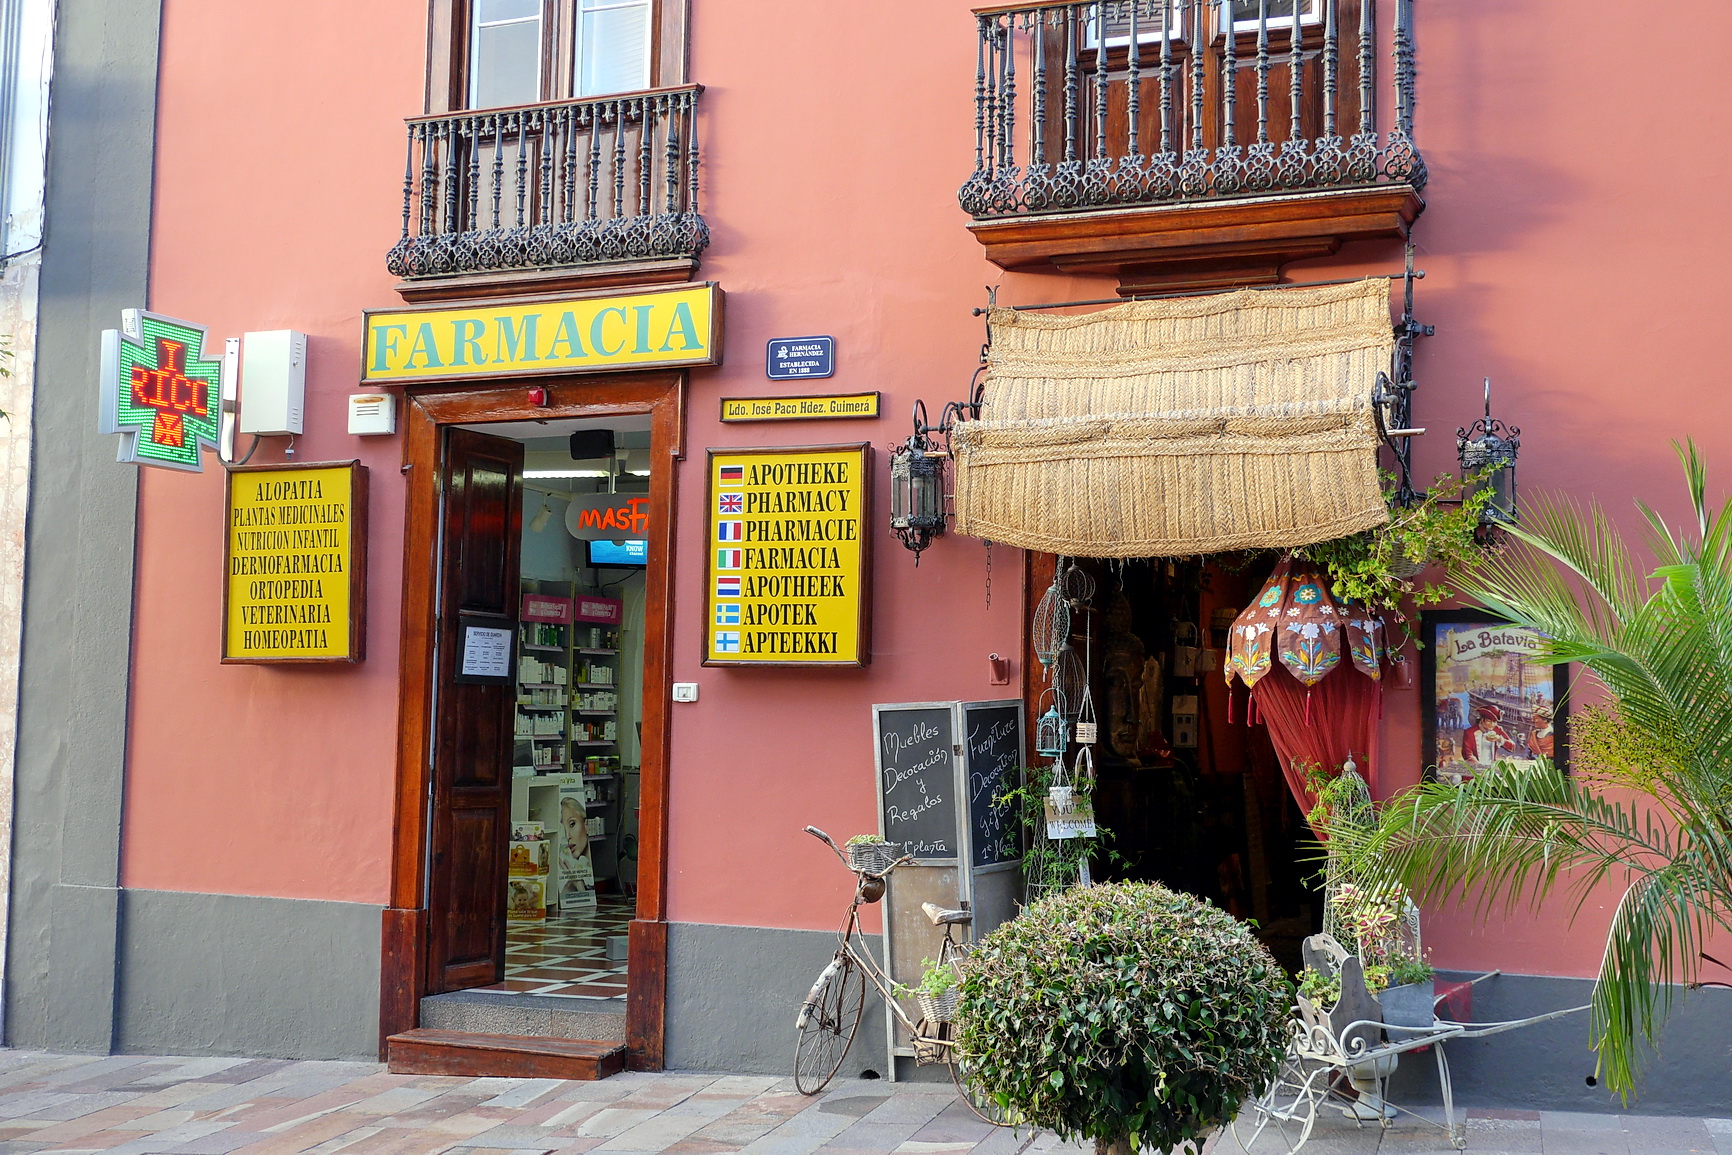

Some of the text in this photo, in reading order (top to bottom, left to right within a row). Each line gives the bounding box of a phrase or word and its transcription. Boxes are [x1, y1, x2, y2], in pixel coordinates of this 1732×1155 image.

[370, 302, 704, 371] FARMACIA
[728, 399, 870, 416] Ldo. José Paco Hdez. Guimerá
[747, 462, 849, 486] APOTHEKE
[255, 480, 323, 502] ALOPATIA
[746, 490, 851, 514] PHARMACY
[233, 503, 345, 527] PLANTAS MEDICINALES
[237, 528, 340, 551] NUTRICION INFANTIL
[745, 518, 857, 542] PHARMACIE
[231, 553, 344, 576] DERMOFARMACIA
[743, 547, 841, 570] FARMACIA
[249, 579, 324, 601] ORTOPEDIA
[743, 575, 846, 598] APOTHEEK
[241, 604, 332, 625] VETERINARIA
[743, 604, 818, 626] APOTEK
[243, 629, 329, 650] HOMEOPATIA
[742, 631, 839, 654] APTEEKKI
[1455, 631, 1537, 654] La Batavia
[883, 721, 940, 763] Muebles
[967, 719, 1016, 760] Furniture
[883, 747, 948, 795] Decoración
[969, 748, 1018, 804] Decoration
[915, 778, 927, 794] y
[886, 794, 942, 825] Regalos
[1049, 819, 1093, 830] WELCOME
[913, 840, 948, 856] planta
